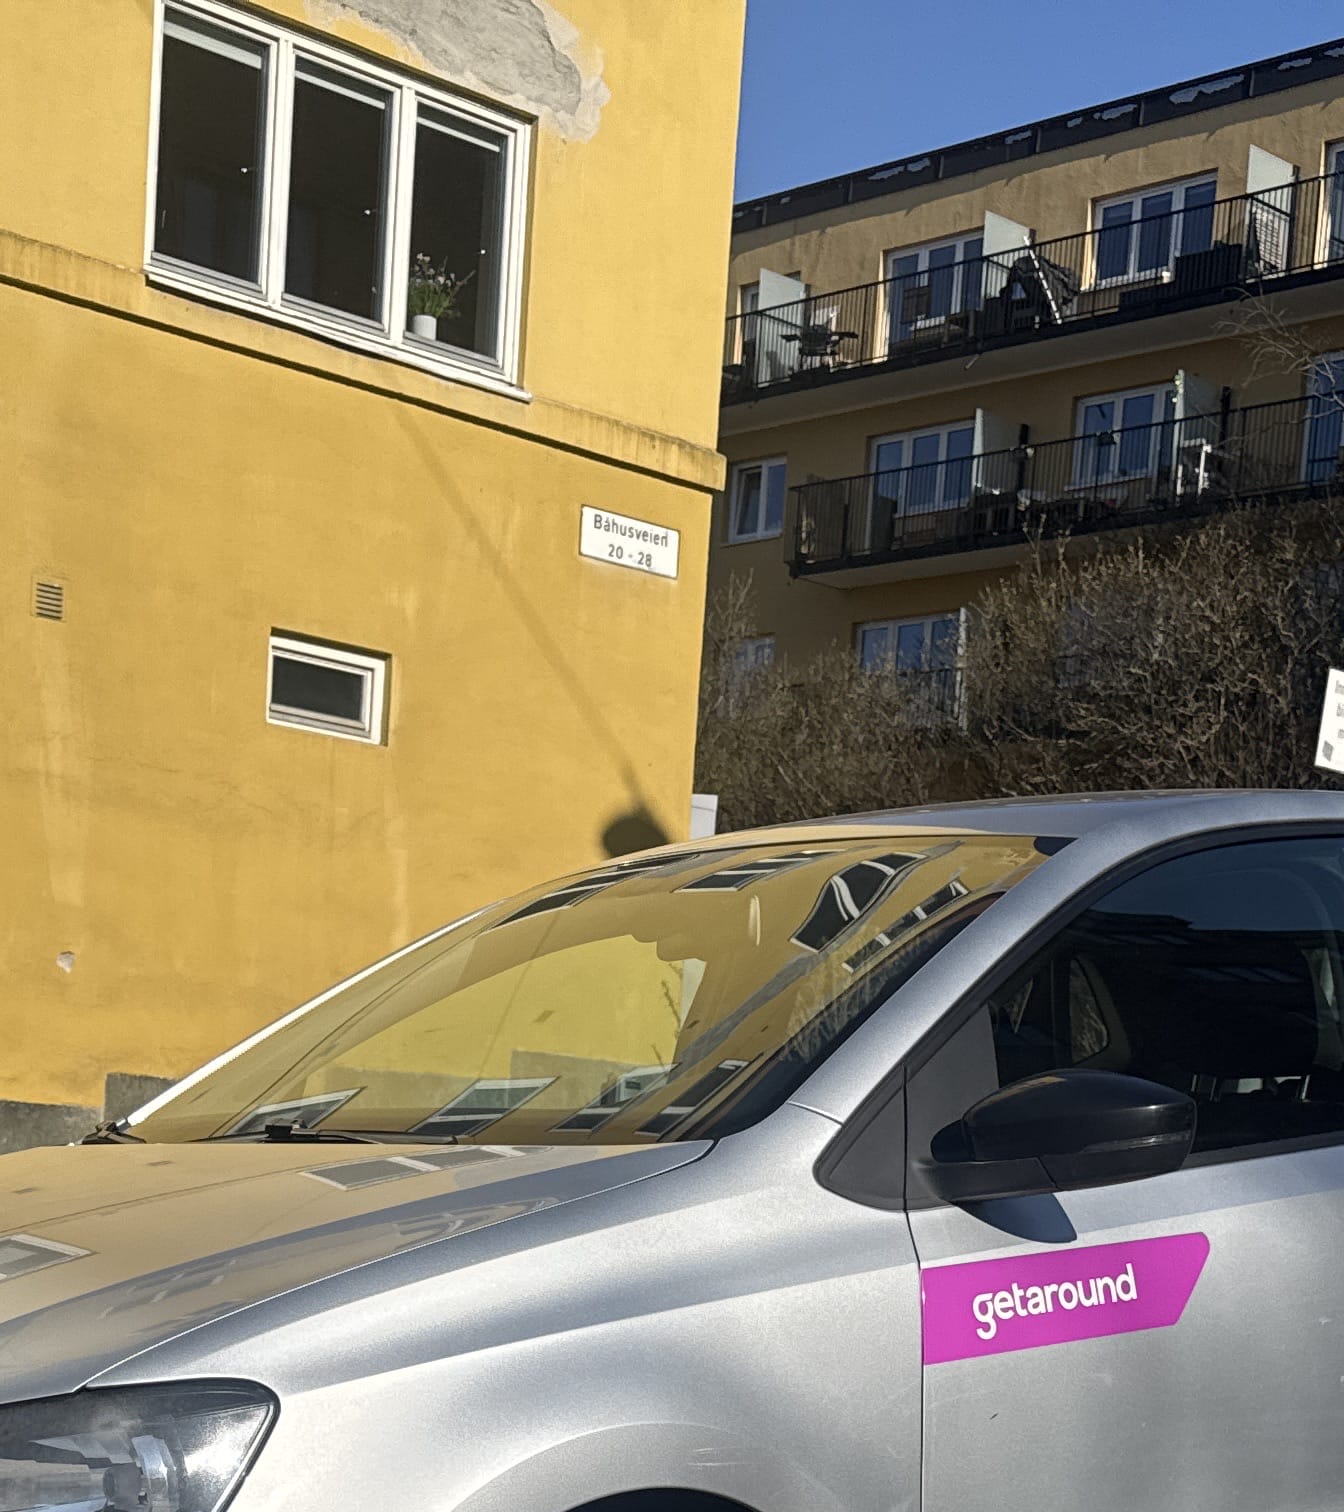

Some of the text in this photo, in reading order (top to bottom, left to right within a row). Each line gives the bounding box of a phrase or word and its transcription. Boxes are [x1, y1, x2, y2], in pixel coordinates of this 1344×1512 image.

[608, 543, 624, 560] 20
[637, 551, 653, 568] 28
[972, 1262, 1138, 1341] getaround
